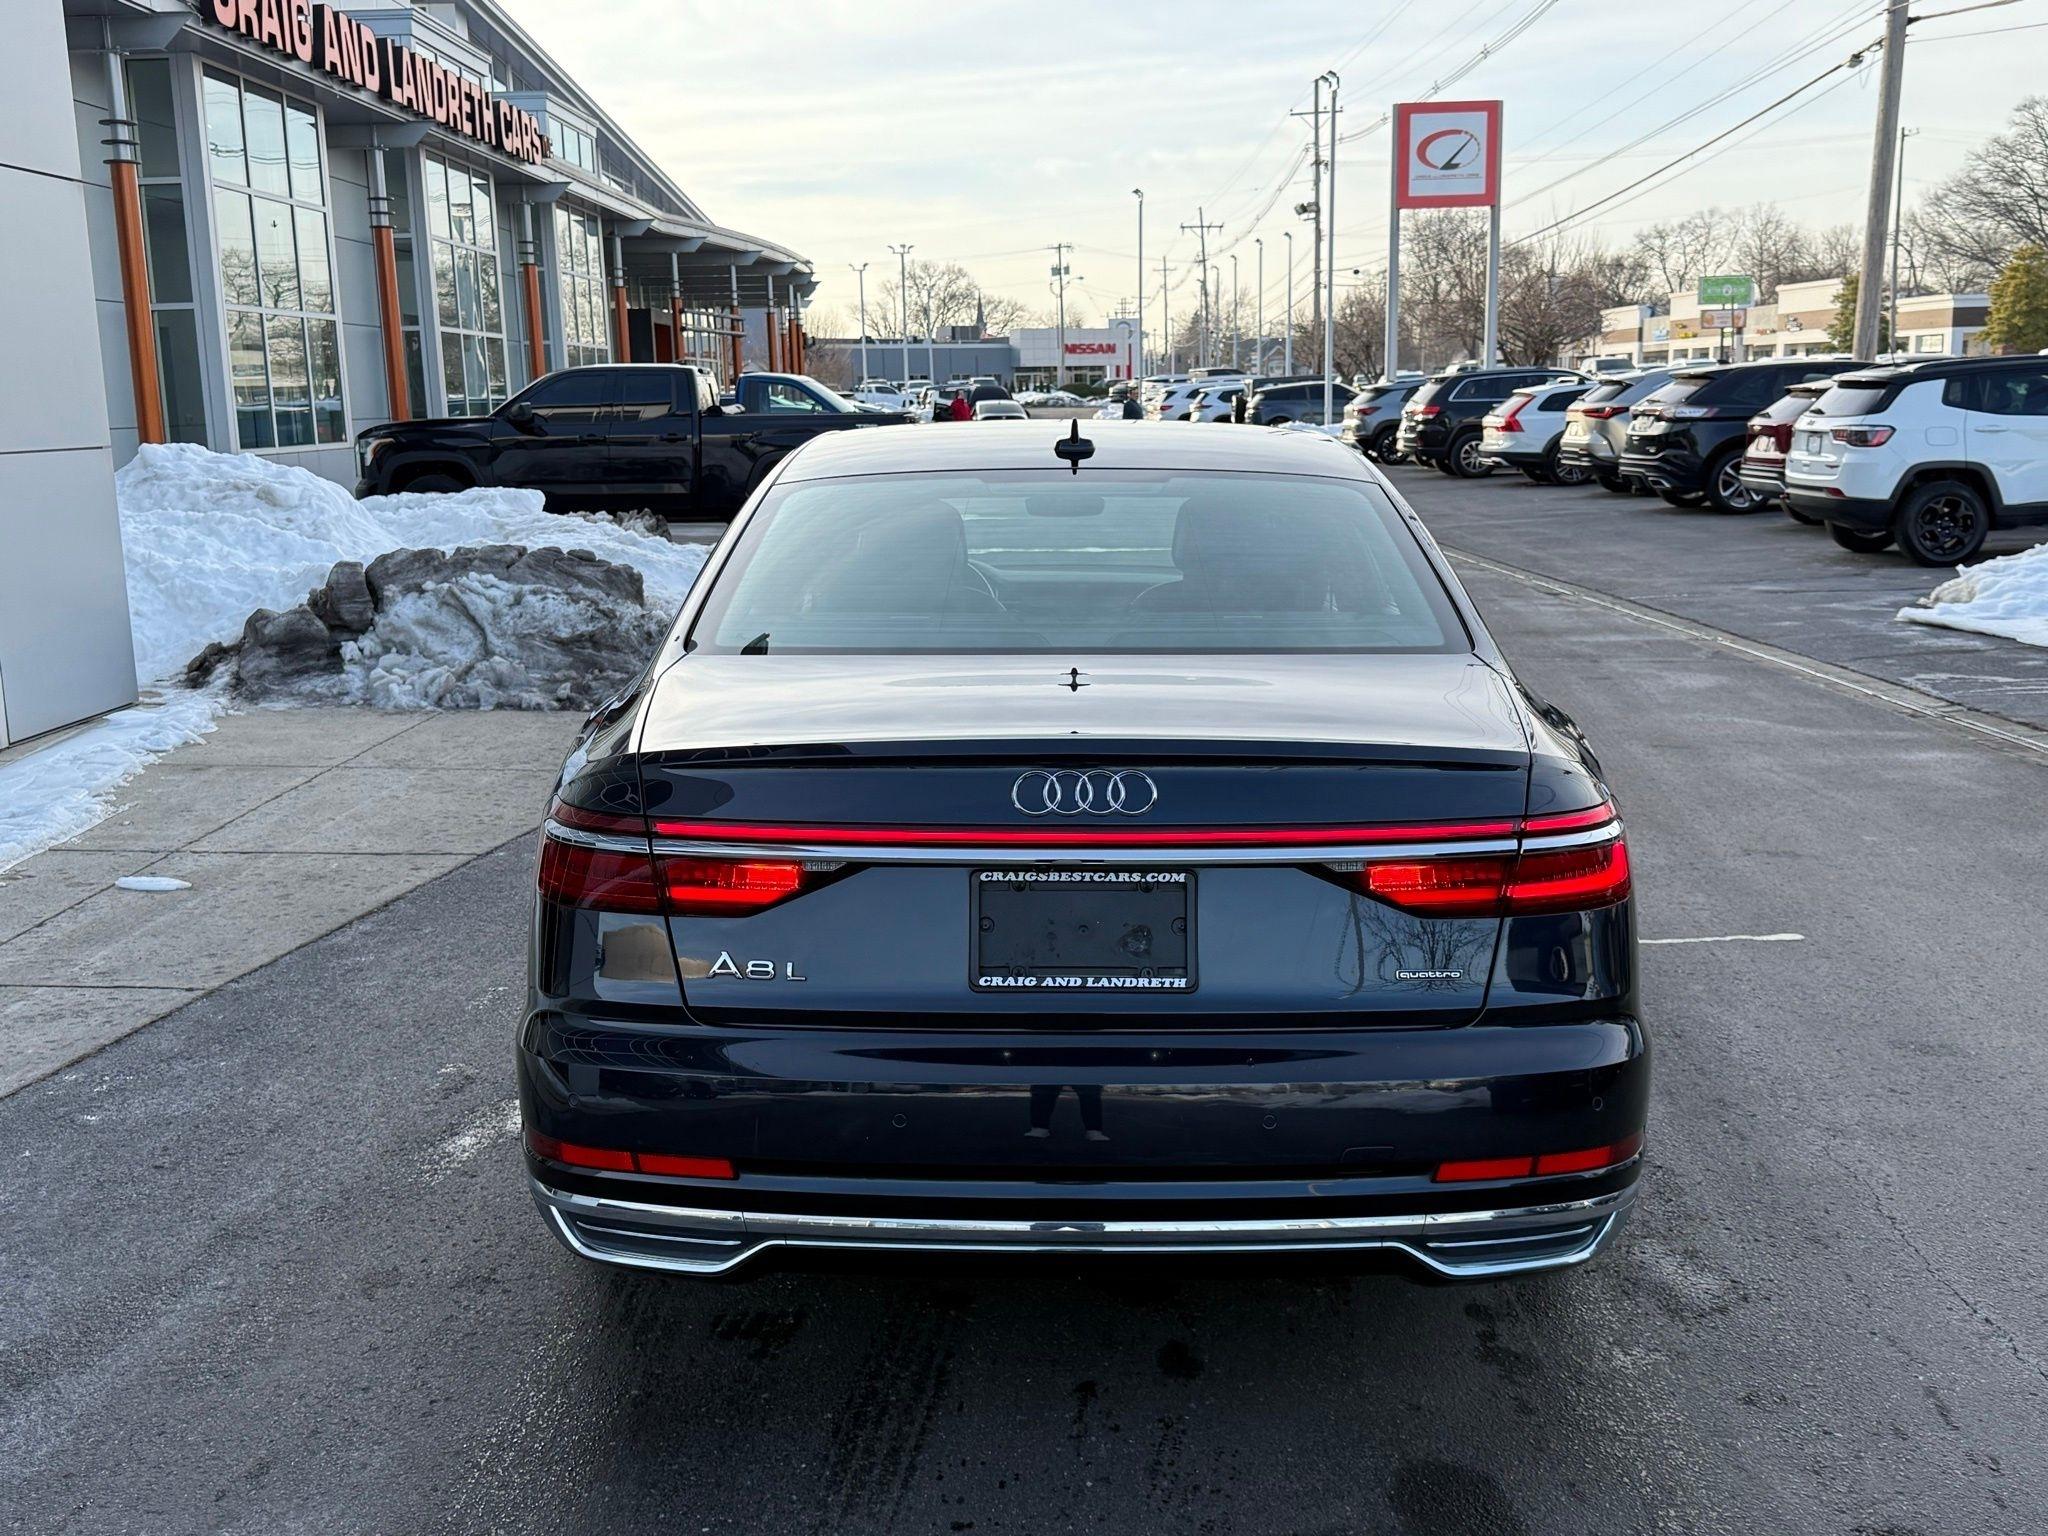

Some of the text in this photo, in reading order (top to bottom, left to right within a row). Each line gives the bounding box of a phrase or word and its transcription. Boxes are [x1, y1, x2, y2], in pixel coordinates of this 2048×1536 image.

[323, 4, 380, 93] AND
[386, 37, 496, 146] LANDRETH
[499, 99, 543, 166] CARS
[1064, 343, 1116, 354] NISSAN
[980, 871, 1186, 883] CRAIGSBESTCARS.COM
[706, 951, 807, 981] A8 L
[1399, 970, 1461, 979] quattro
[978, 976, 1187, 988] CRAIG AND LANDRETH
